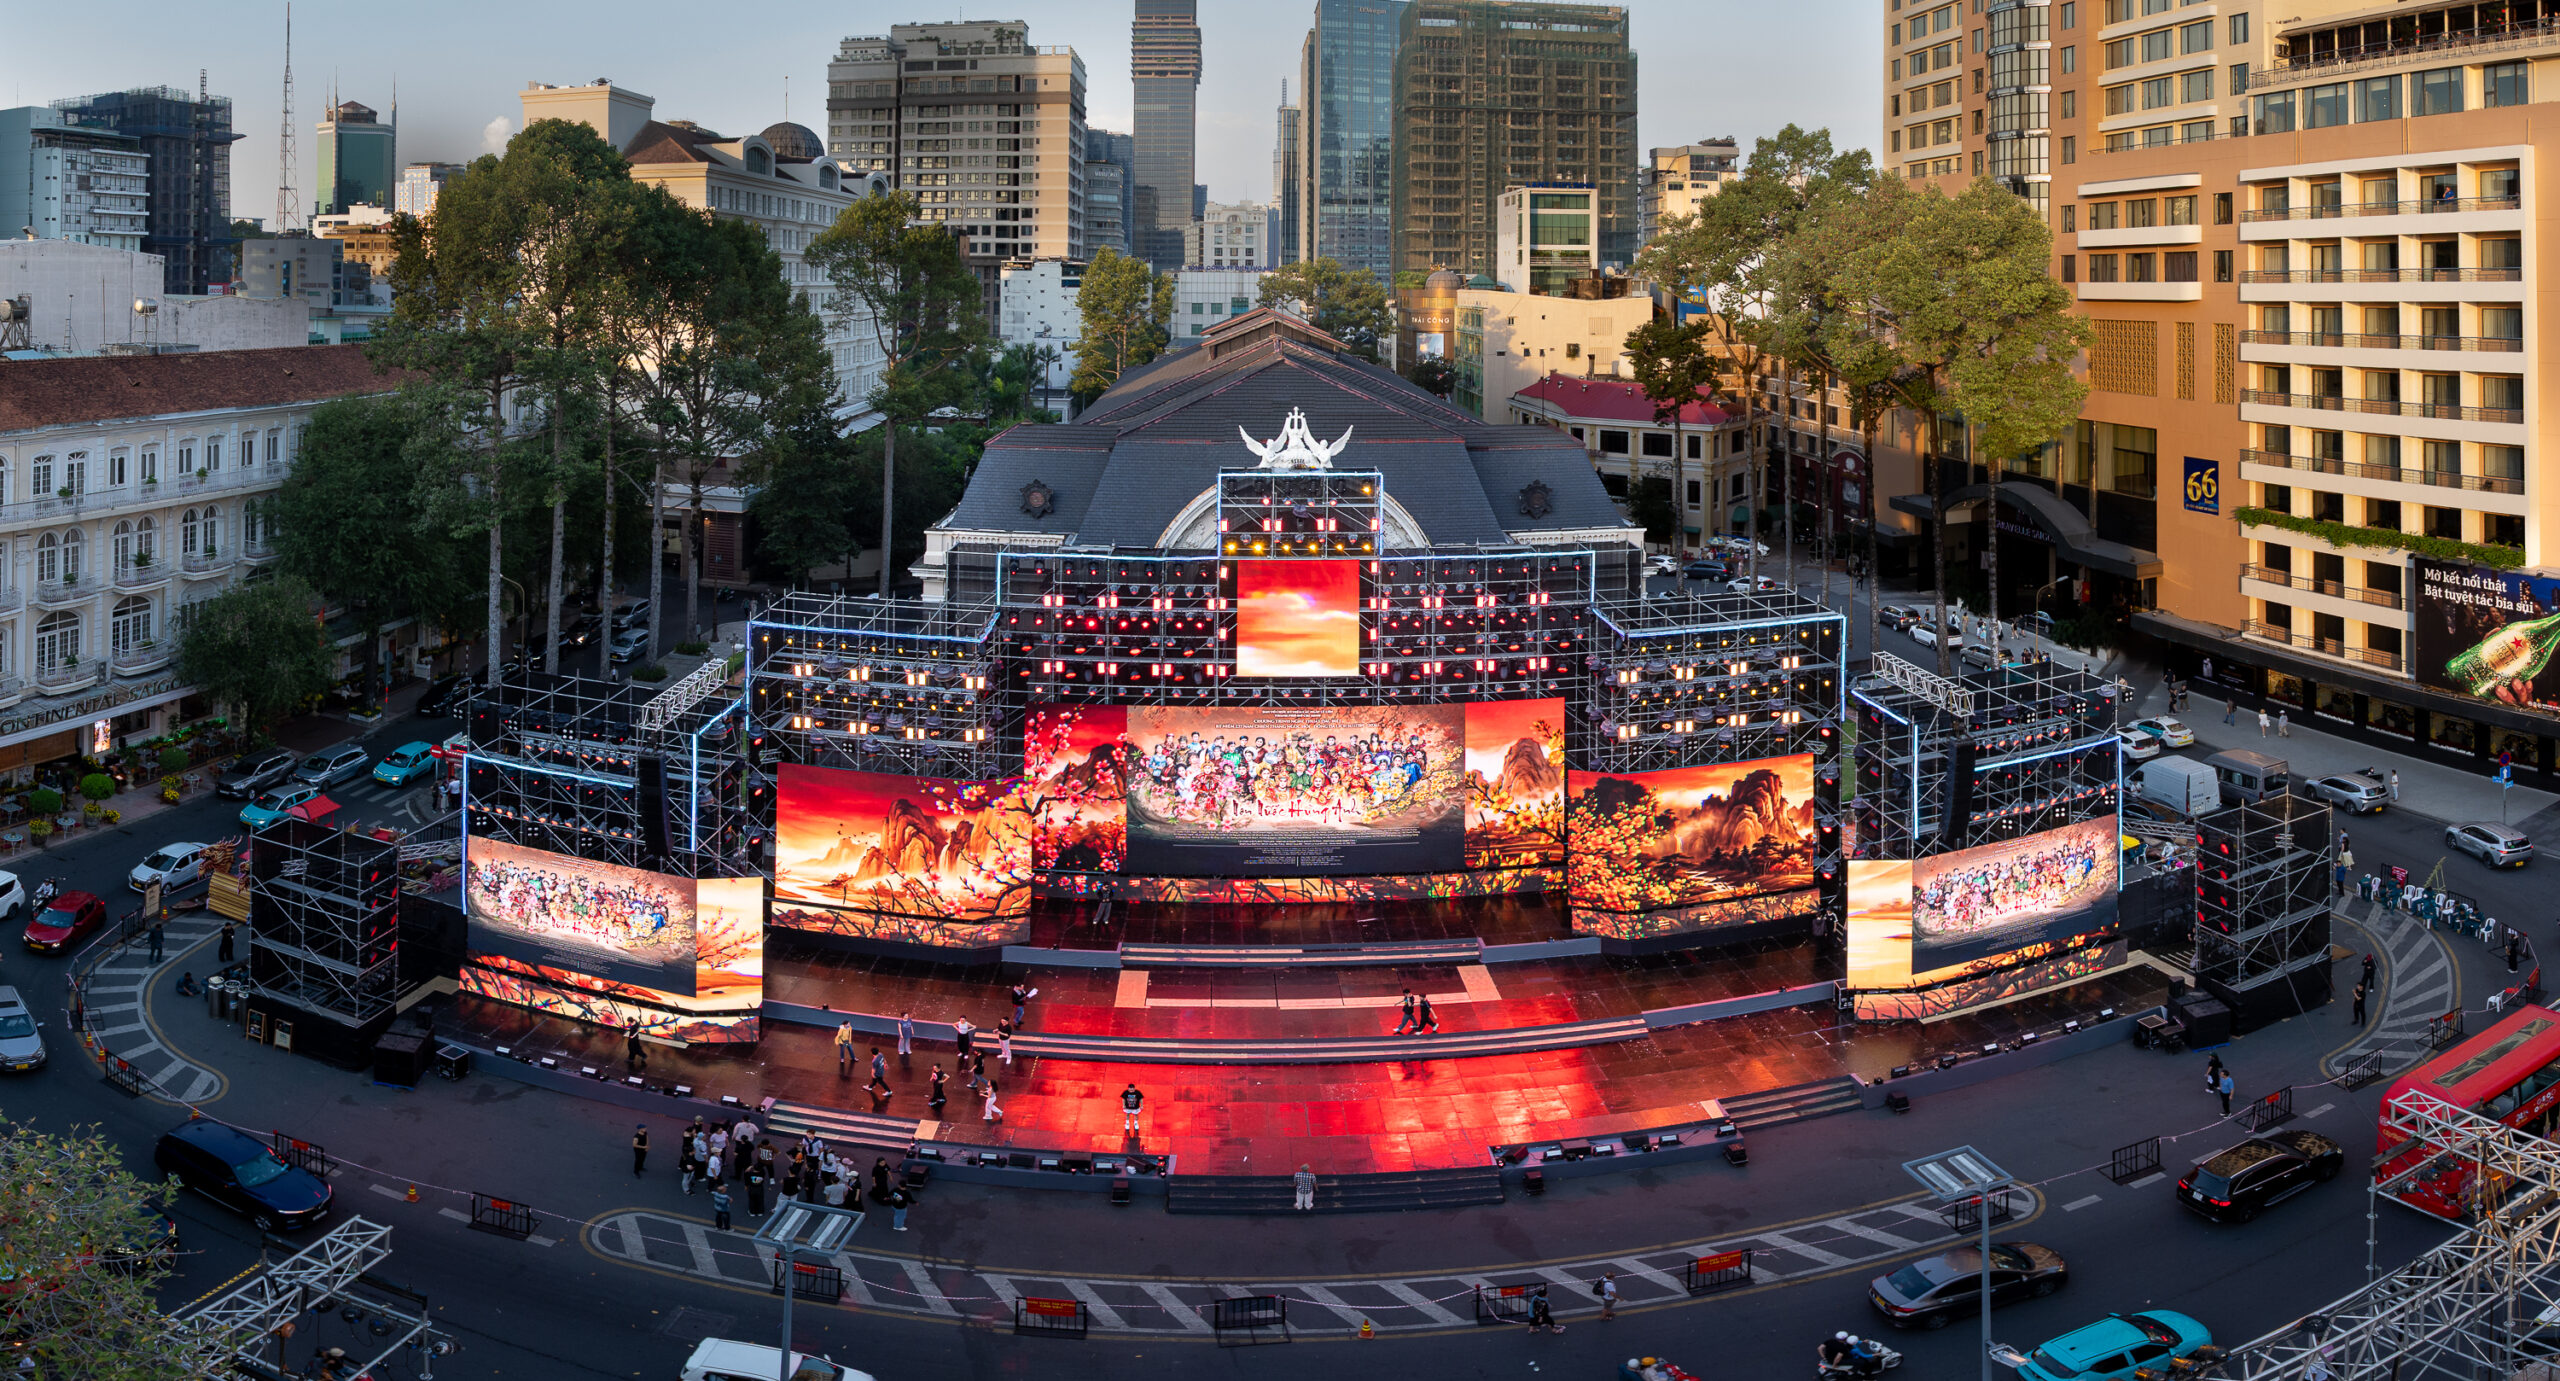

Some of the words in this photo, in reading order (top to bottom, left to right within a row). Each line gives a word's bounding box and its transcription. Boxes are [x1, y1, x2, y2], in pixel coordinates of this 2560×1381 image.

[2187, 468, 2217, 502] 66
[2424, 568, 2441, 581] Mở
[2443, 569, 2460, 585] kết
[2462, 574, 2480, 589] nối
[2483, 578, 2507, 595] thật
[2424, 584, 2443, 601] Bật
[2444, 588, 2473, 605] tuyệt
[2475, 592, 2494, 607] tác
[2495, 596, 2514, 610] bia
[2516, 600, 2534, 614] sủi
